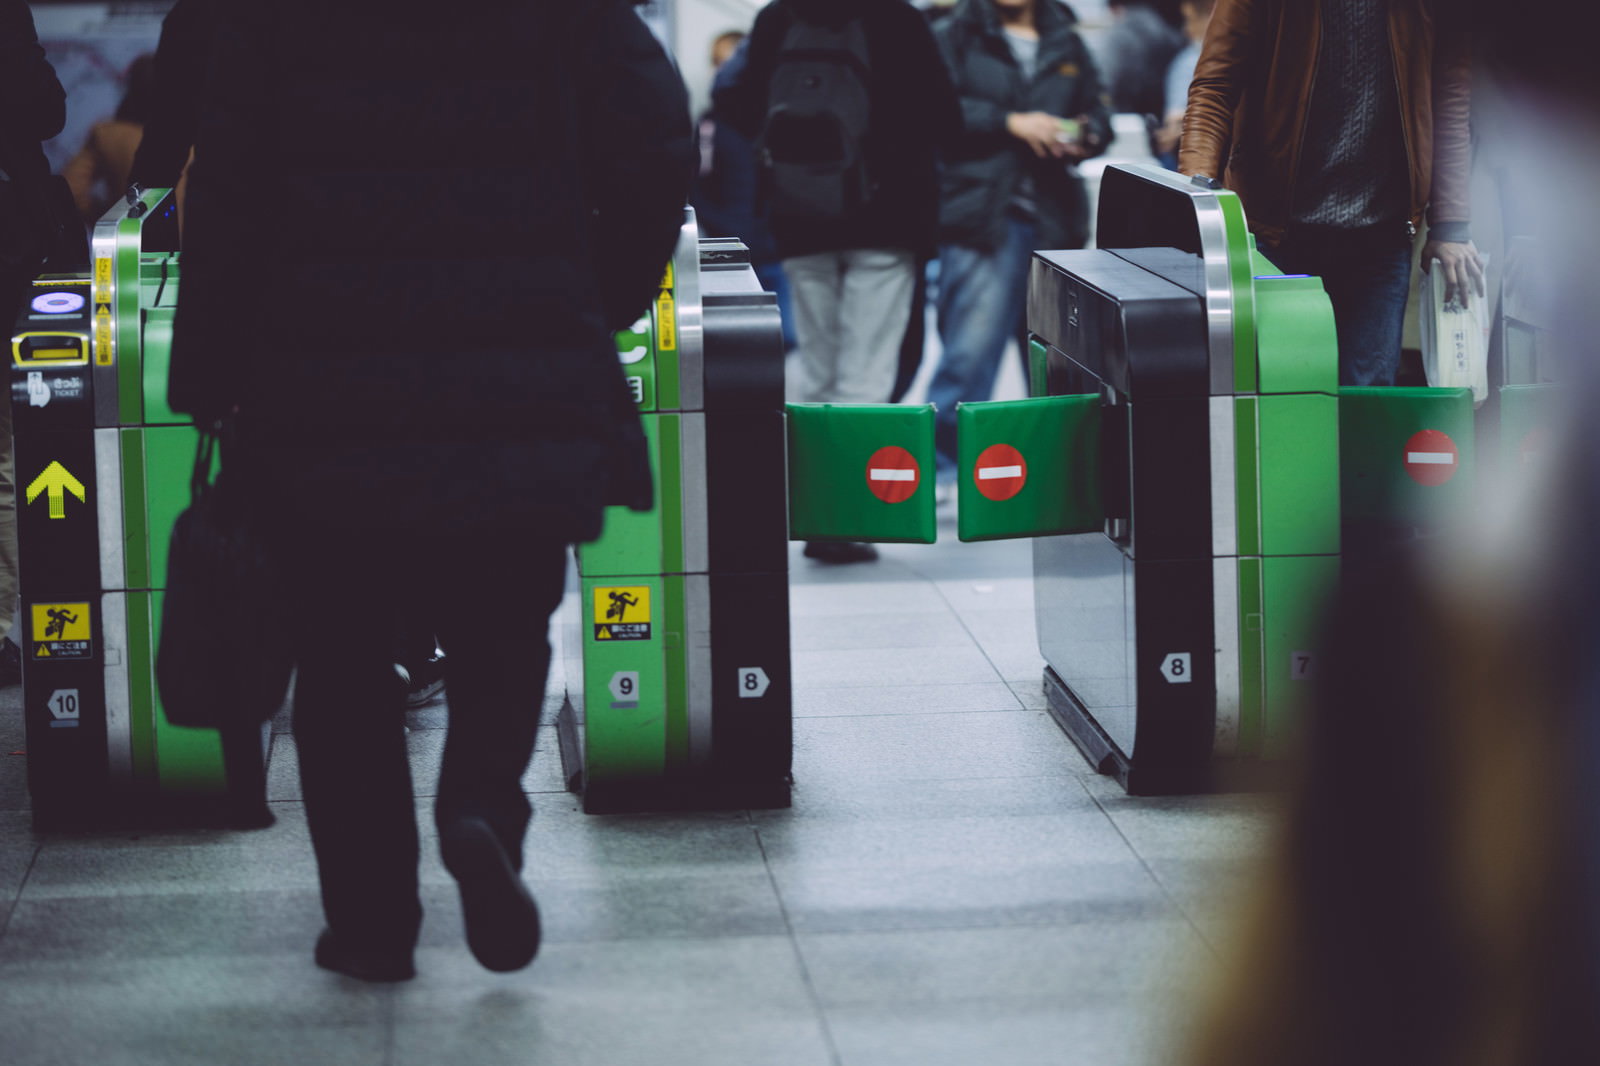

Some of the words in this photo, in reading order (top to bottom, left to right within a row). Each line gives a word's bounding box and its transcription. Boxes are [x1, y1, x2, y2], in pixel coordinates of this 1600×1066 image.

[55, 389, 79, 397] TICKET
[1171, 658, 1185, 676] 8
[1297, 656, 1310, 674] 7
[619, 677, 633, 695] 9
[744, 673, 758, 691] 8
[56, 694, 76, 713] 10
